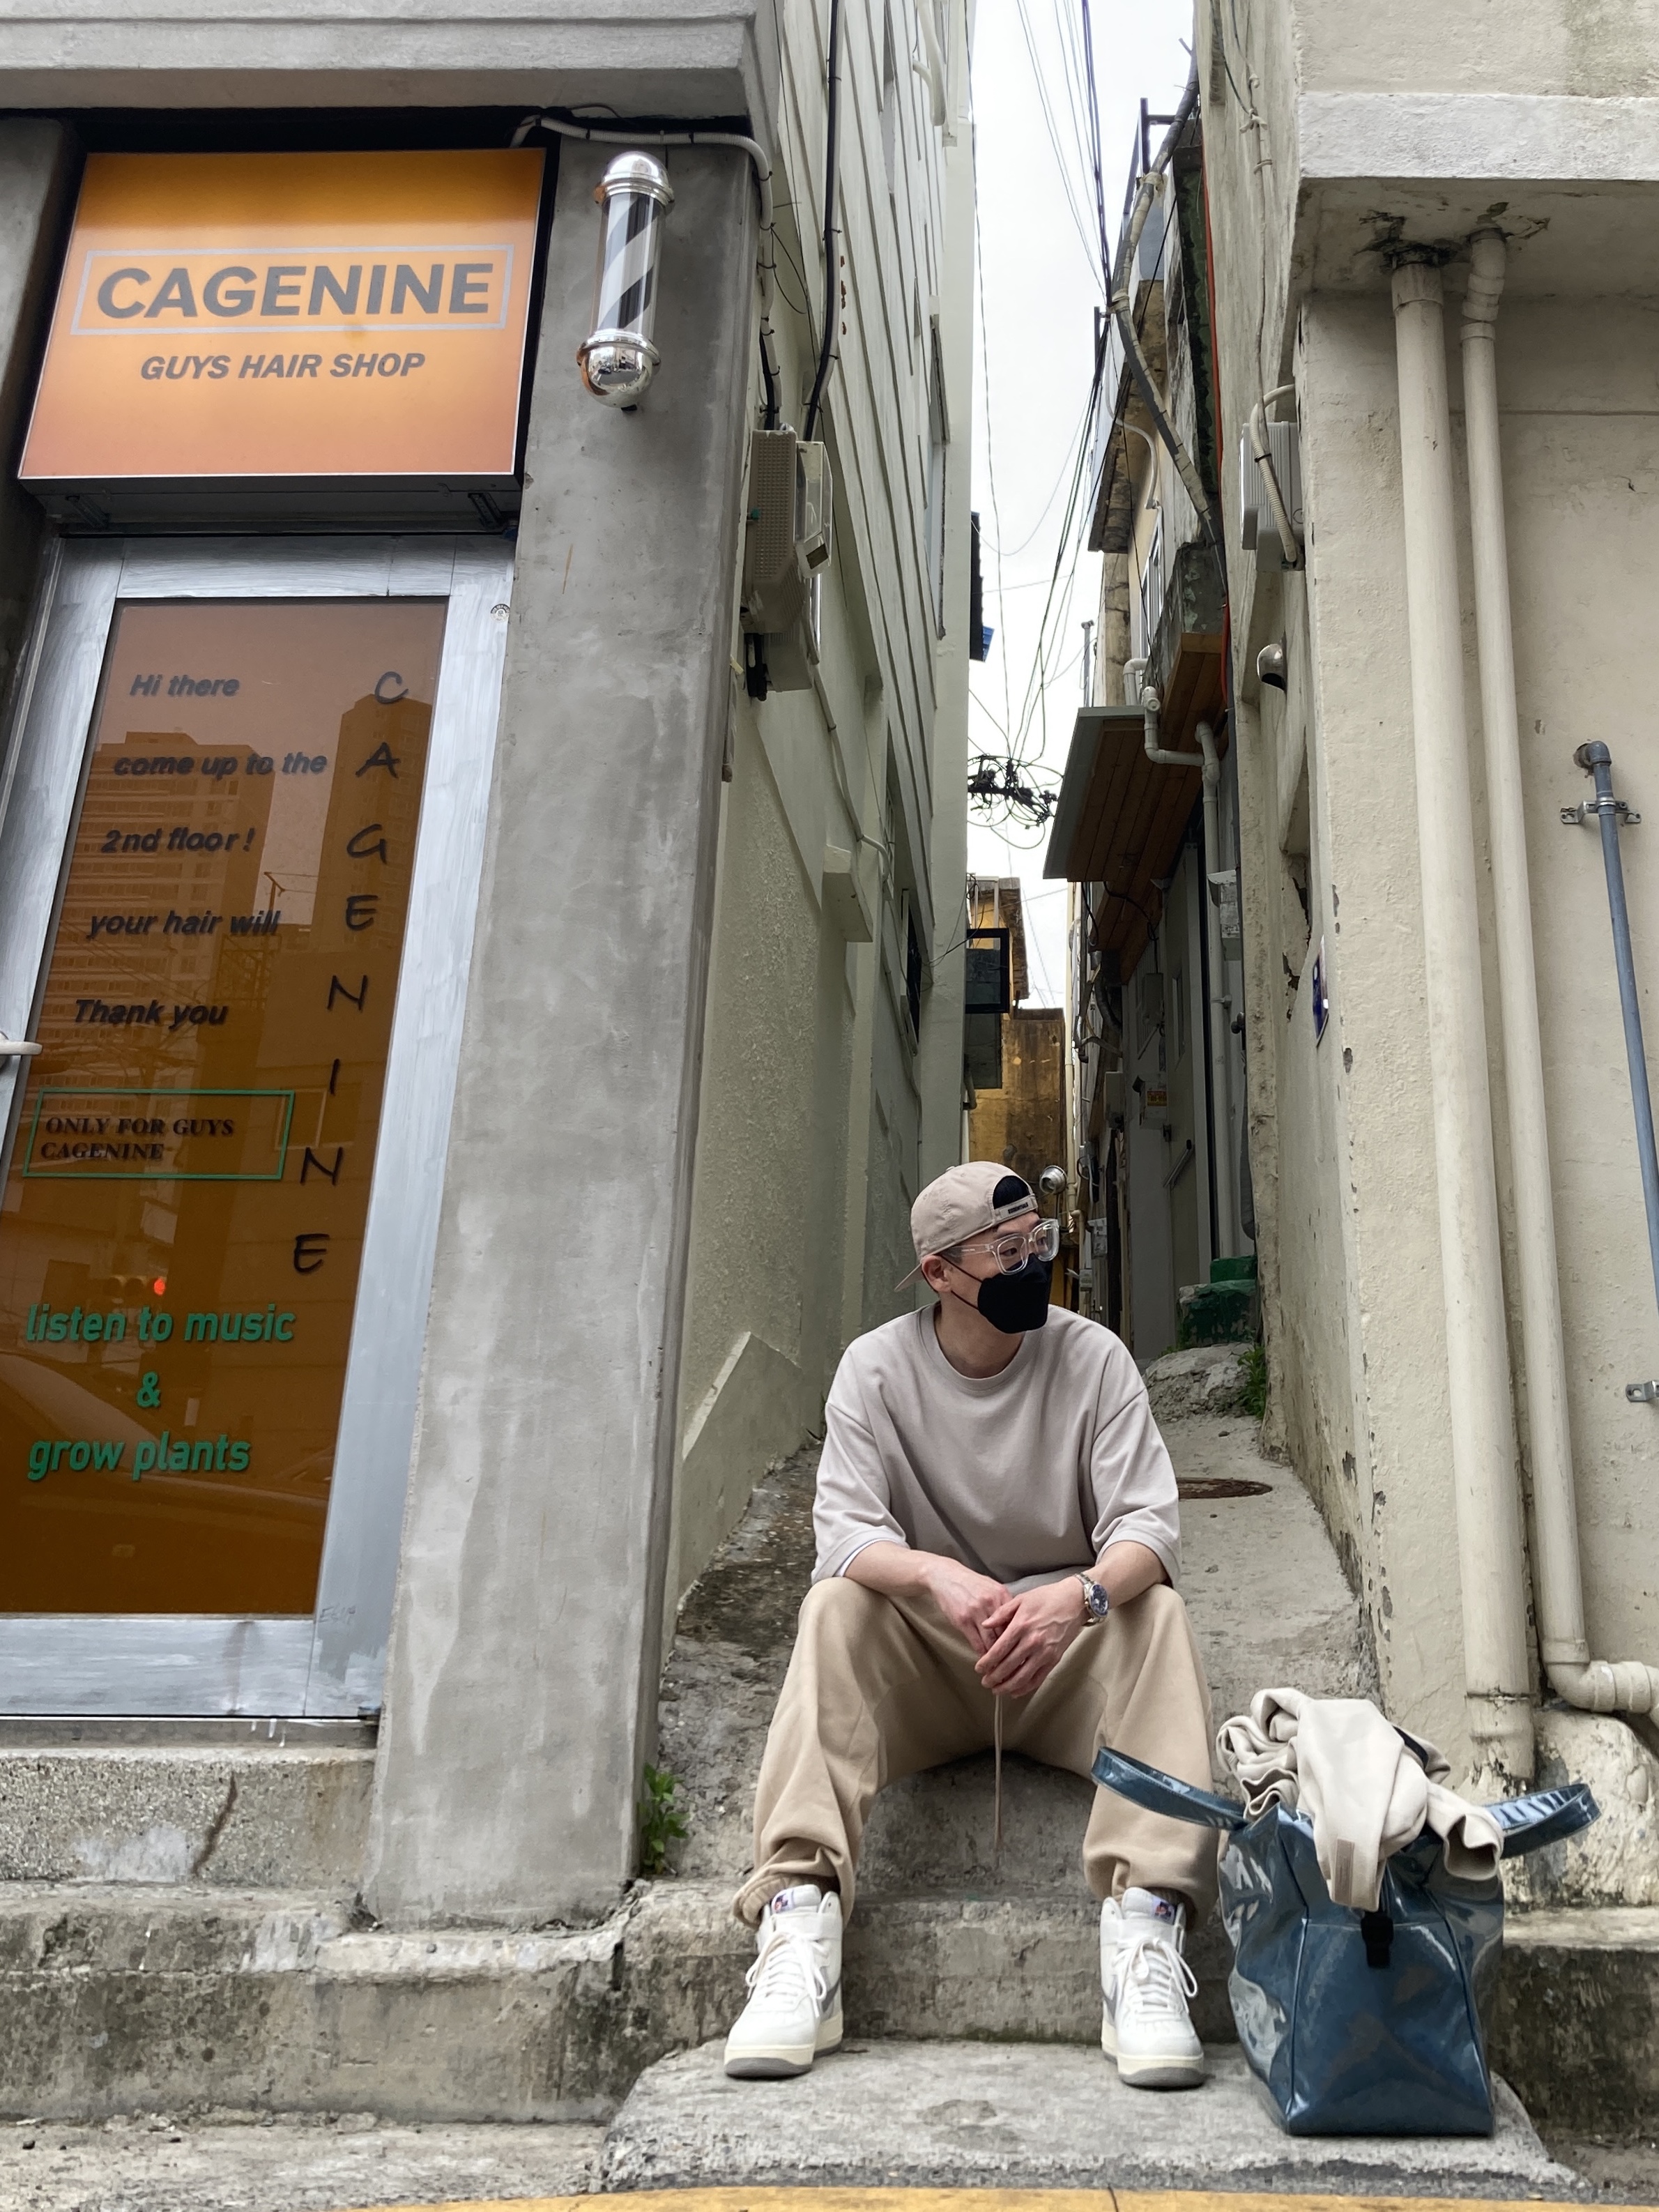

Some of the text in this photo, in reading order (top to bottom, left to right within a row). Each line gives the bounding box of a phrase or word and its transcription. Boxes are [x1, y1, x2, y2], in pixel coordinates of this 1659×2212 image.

[97, 263, 494, 319] CAGENINE
[141, 353, 425, 380] GUYS HAIR SHOP
[130, 674, 240, 696] Hi there
[114, 752, 328, 781] come up to the
[102, 827, 161, 853] 2nd
[87, 910, 280, 940] your hair will
[75, 1000, 228, 1030] Thank you
[45, 1118, 234, 1136] ONLY FOR GUYS
[40, 1142, 165, 1161] CAGENINE
[26, 1304, 296, 1342] listen to music
[137, 1371, 160, 1408] &
[27, 1431, 251, 1481] grow plants
